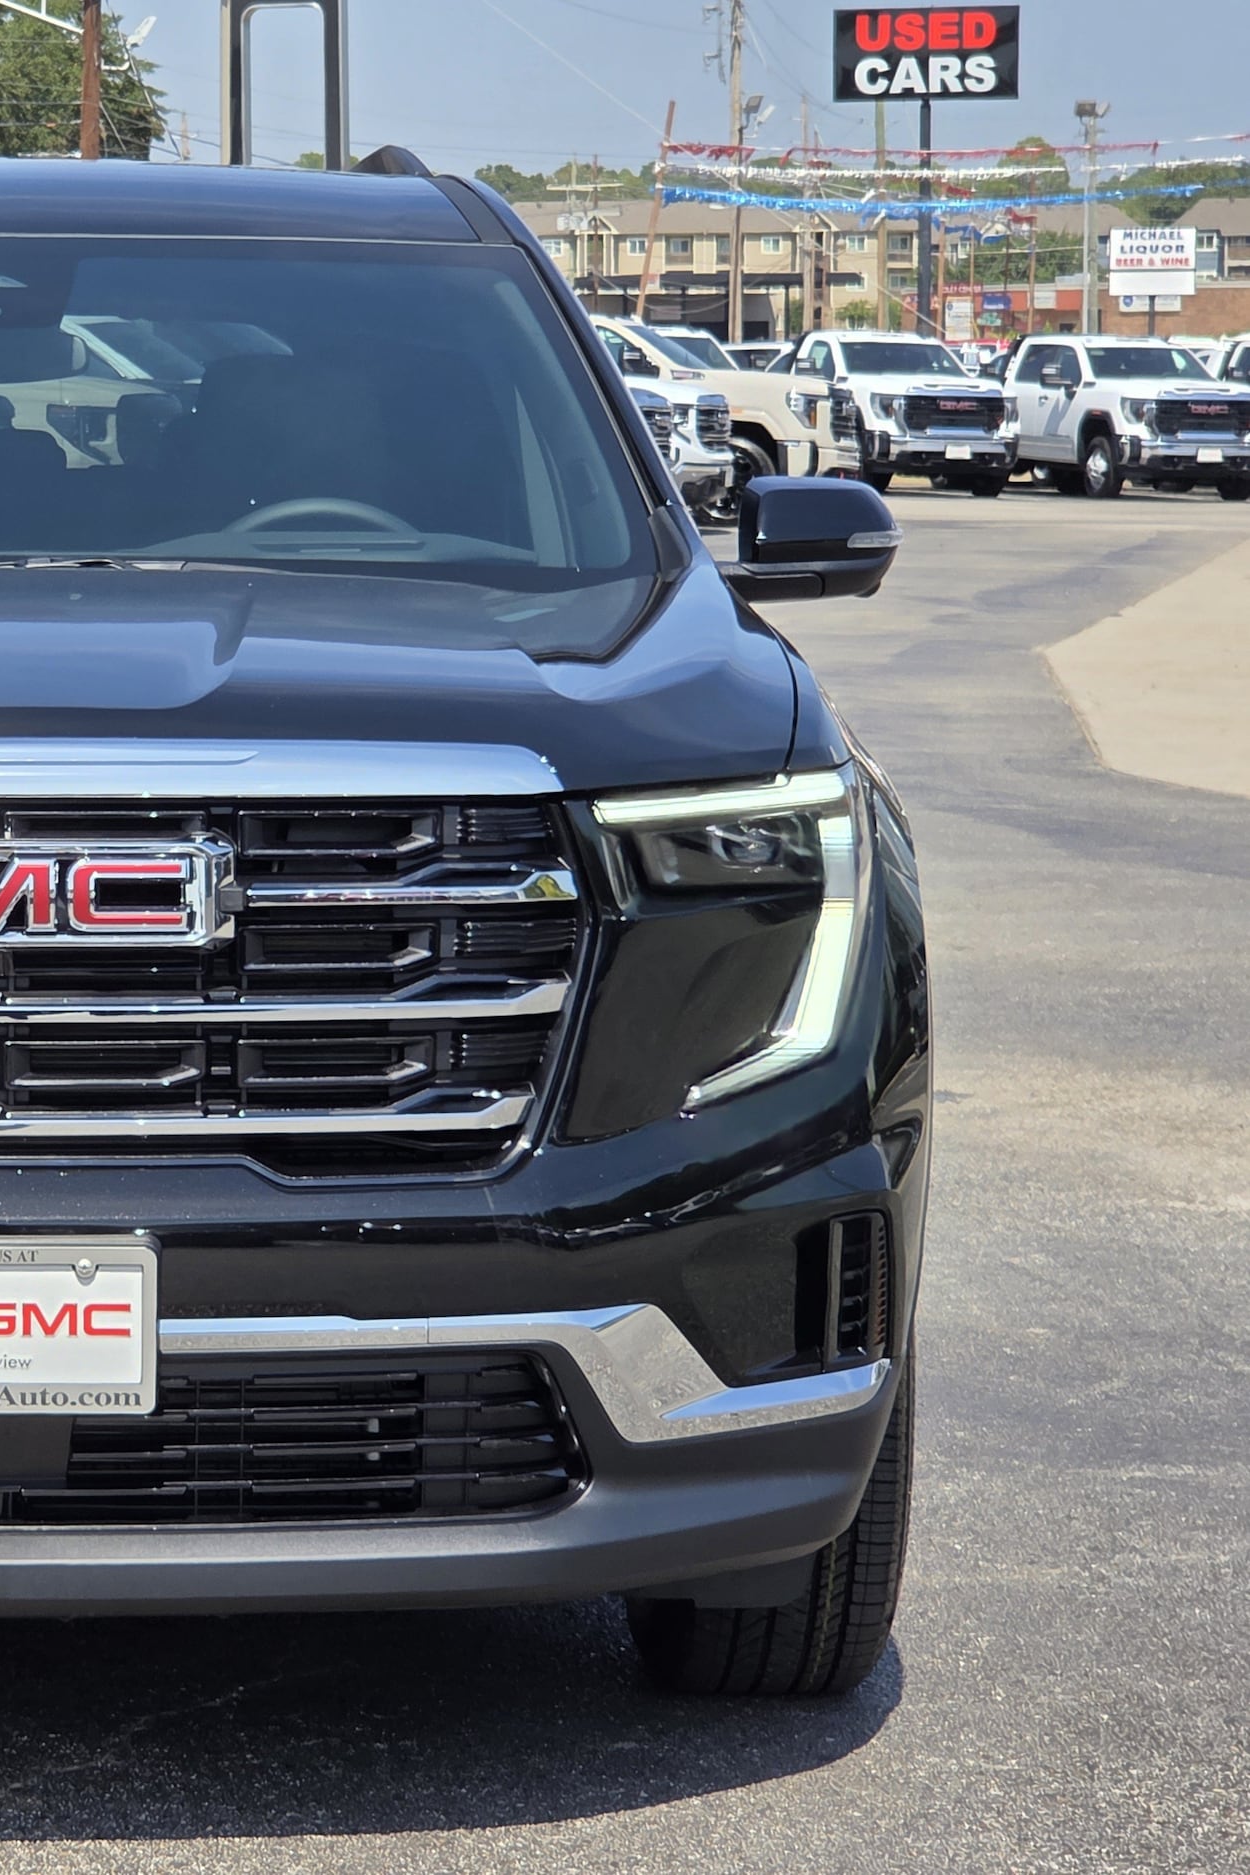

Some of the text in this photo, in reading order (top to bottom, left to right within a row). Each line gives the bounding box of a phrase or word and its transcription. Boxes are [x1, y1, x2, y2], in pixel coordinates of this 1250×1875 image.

[855, 12, 997, 52] USED
[854, 56, 998, 95] CARS
[1123, 231, 1183, 240] MICHAEL
[1120, 245, 1185, 254] LIQUOR
[1116, 258, 1143, 267] BEER
[1160, 258, 1190, 267] WINE
[16, 1250, 39, 1262] AT
